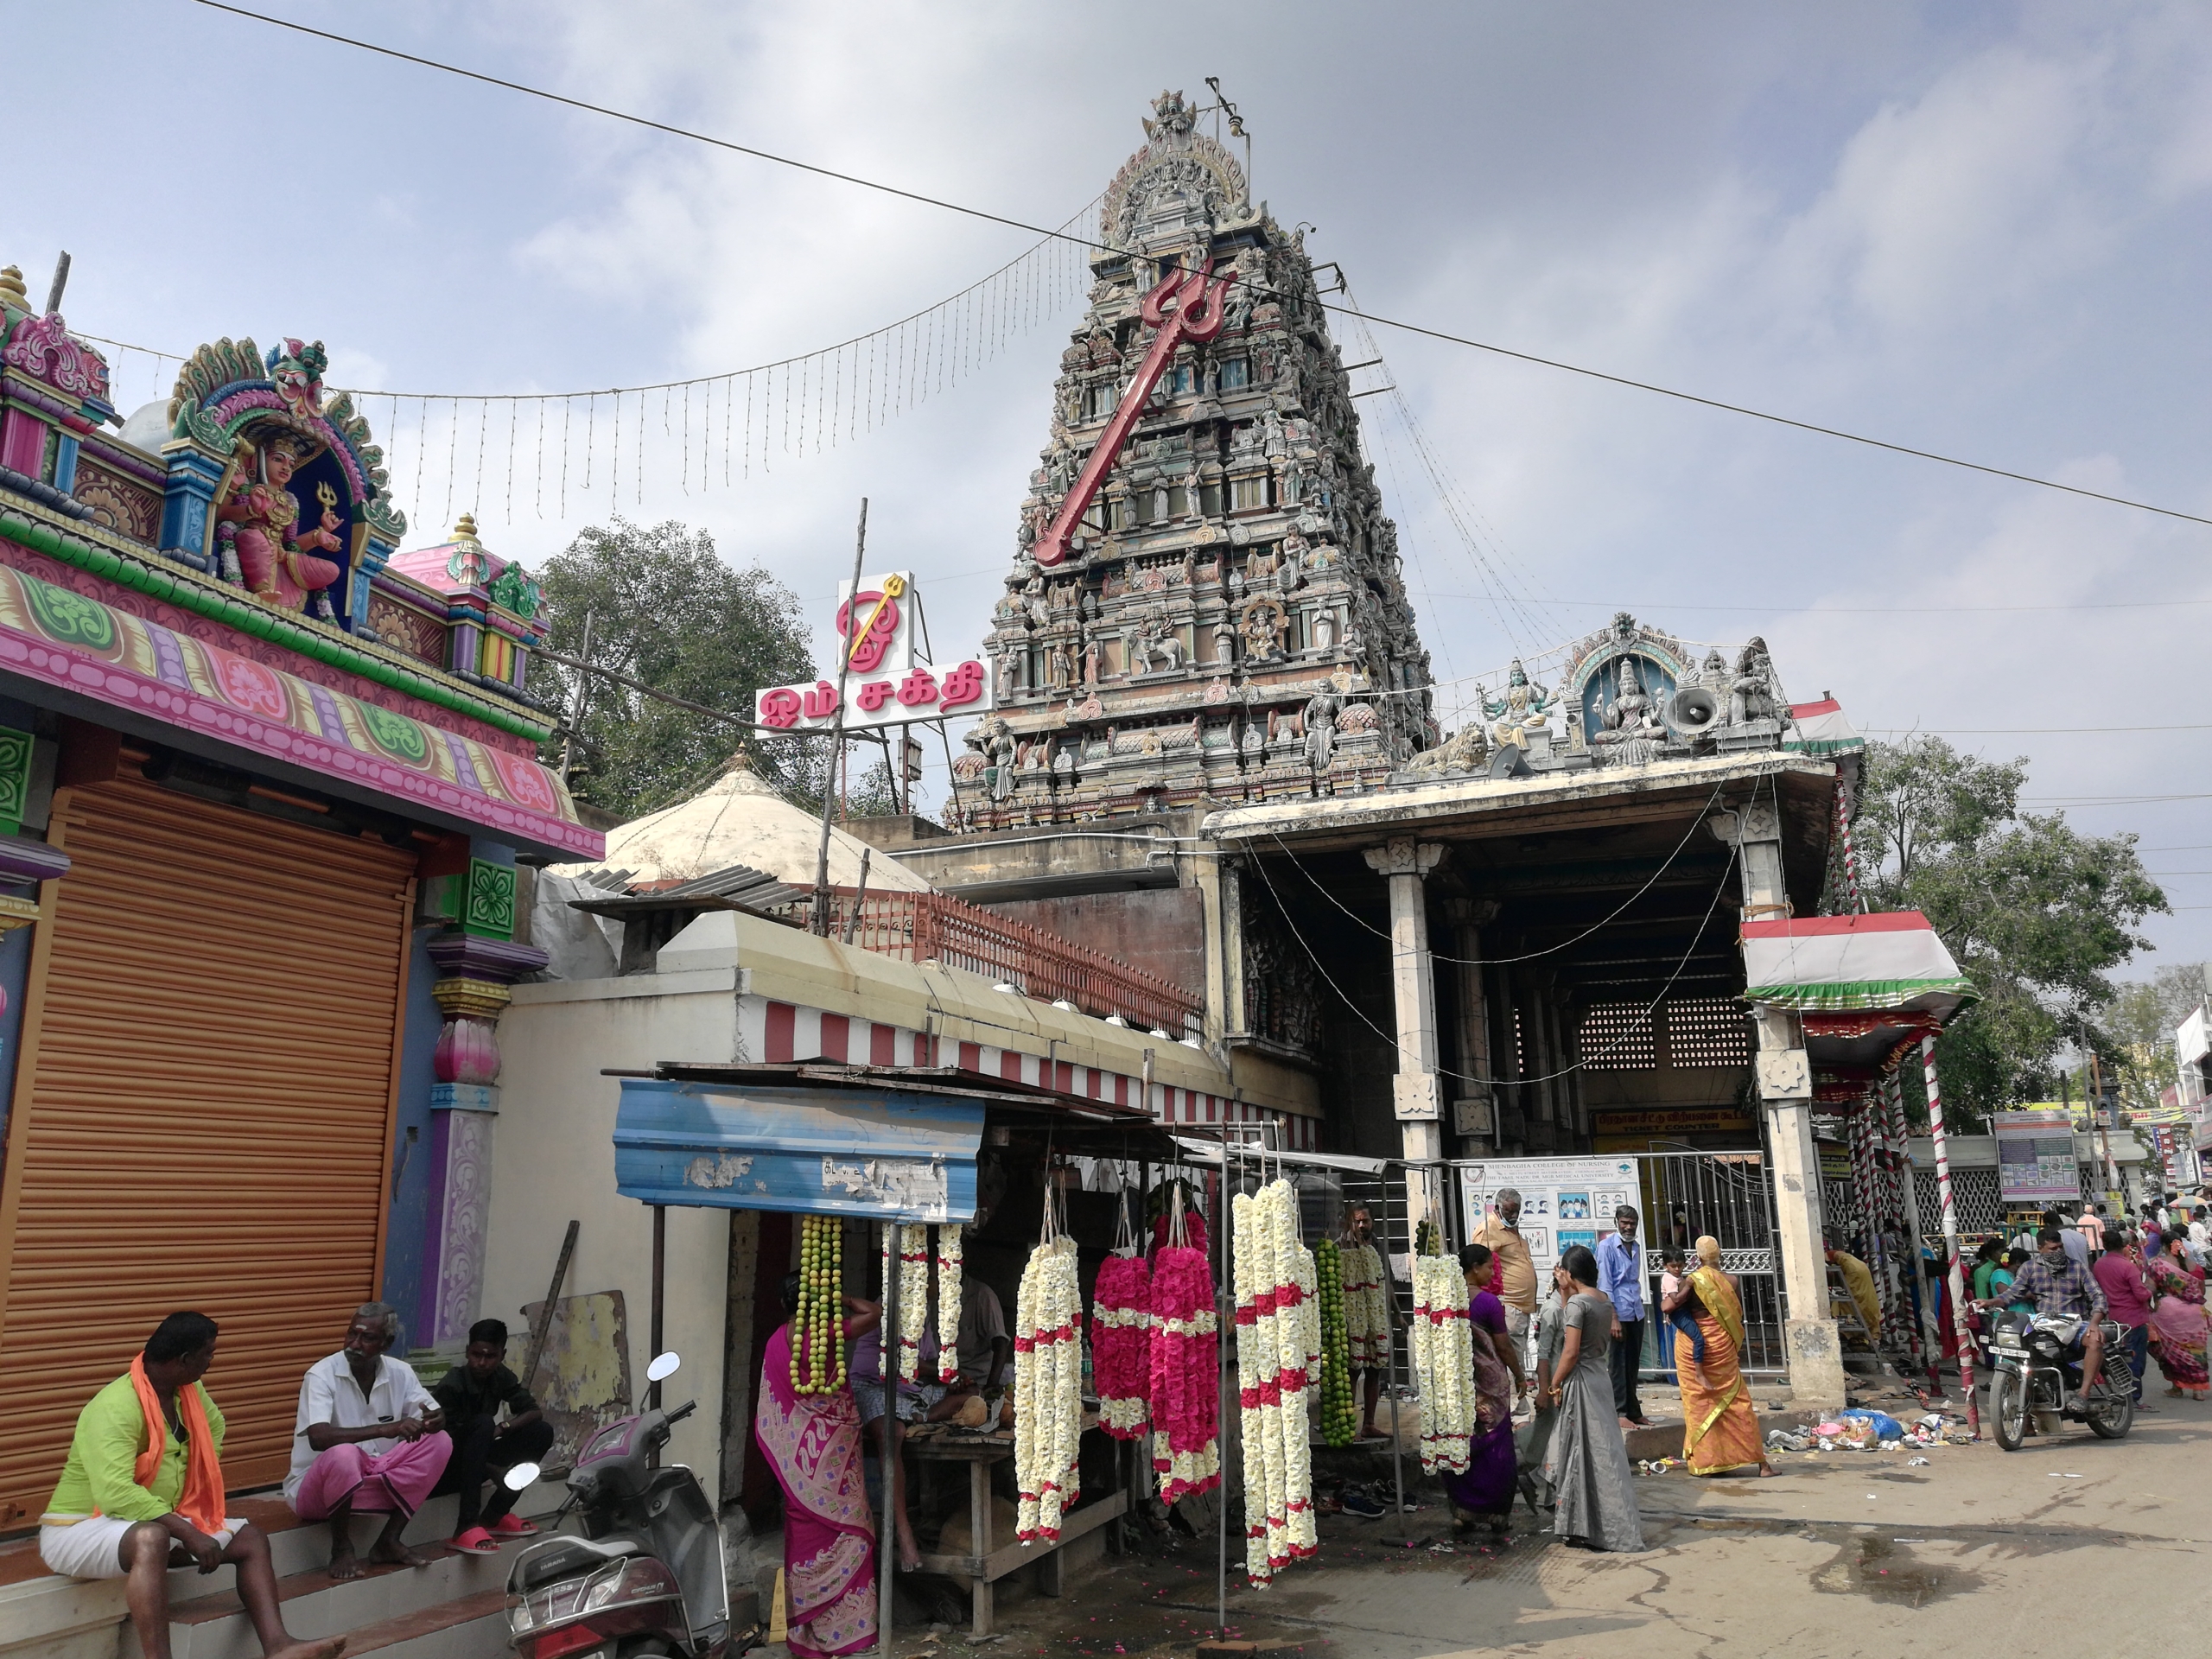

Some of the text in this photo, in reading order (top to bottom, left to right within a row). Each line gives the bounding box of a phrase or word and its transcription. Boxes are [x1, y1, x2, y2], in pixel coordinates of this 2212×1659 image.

[856, 660, 984, 714] சக்தி
[1667, 1111, 1719, 1124] விற்பனை
[540, 1556, 566, 1571] YAMAHA
